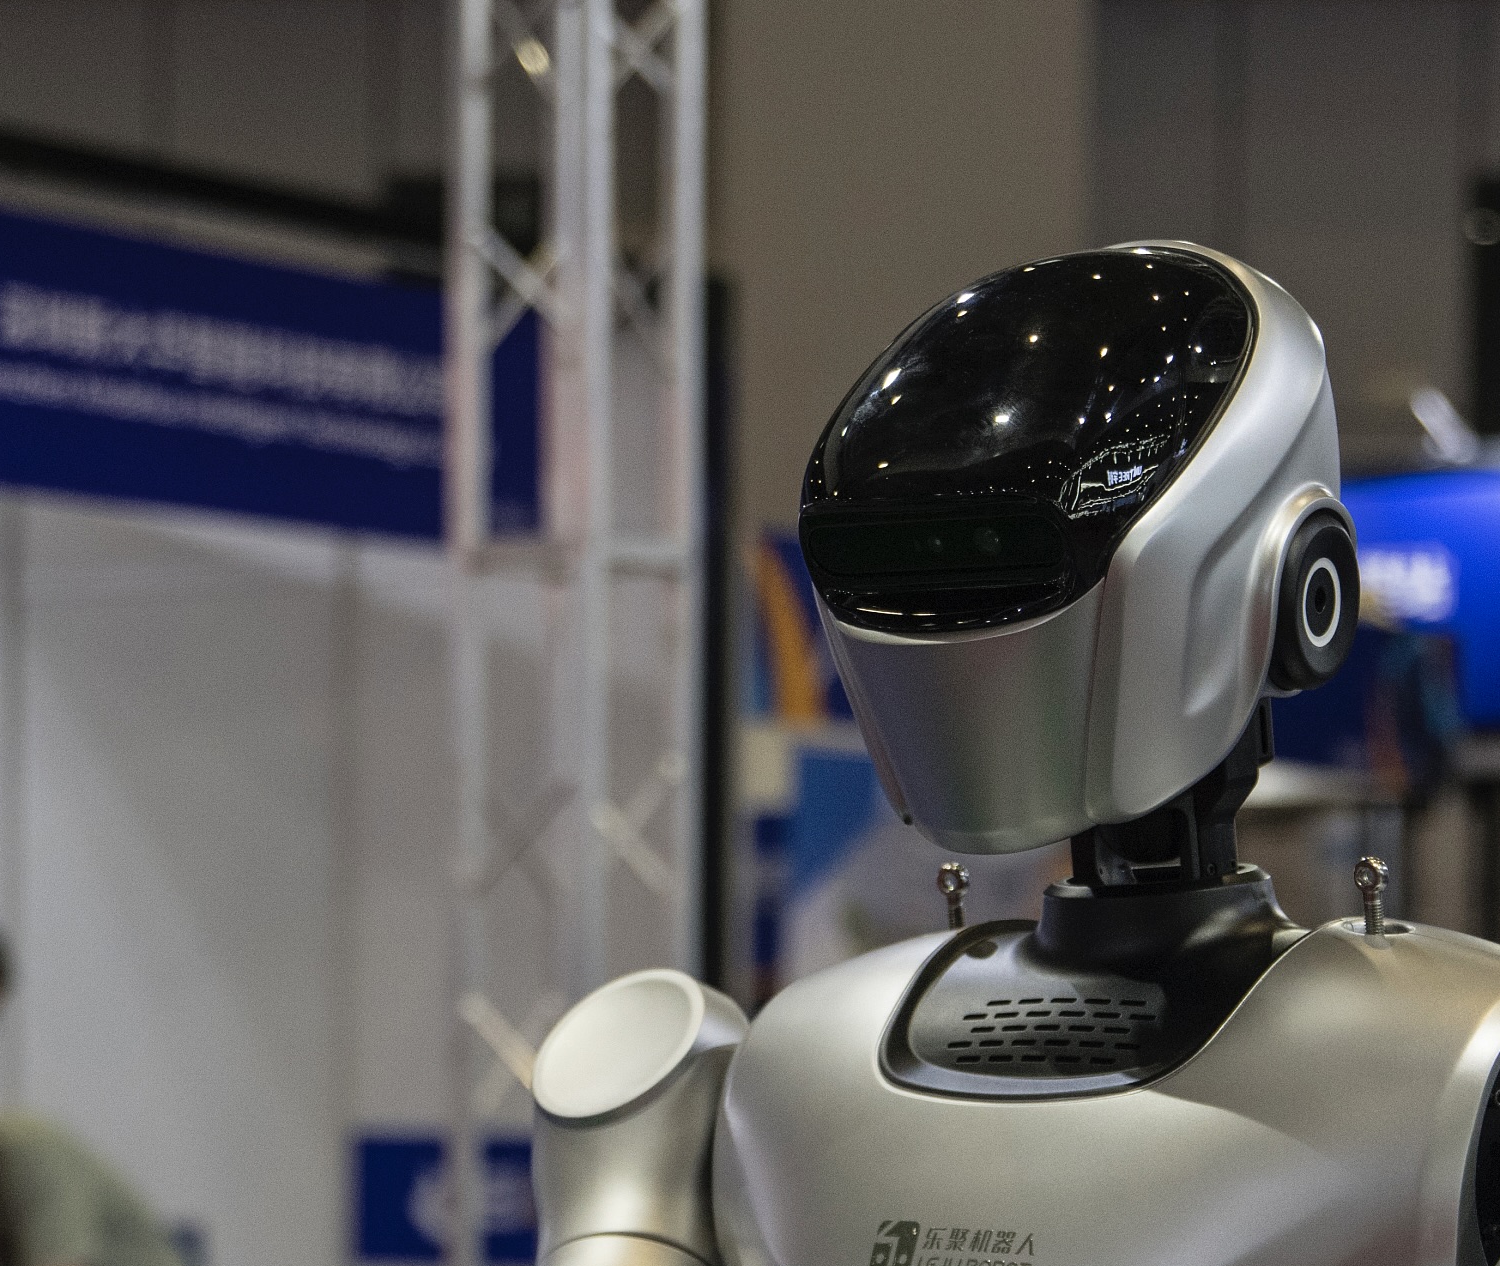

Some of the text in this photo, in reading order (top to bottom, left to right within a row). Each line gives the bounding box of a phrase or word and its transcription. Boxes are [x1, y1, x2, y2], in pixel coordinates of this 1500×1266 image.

[921, 1227, 1035, 1256] 乐聚机器人
